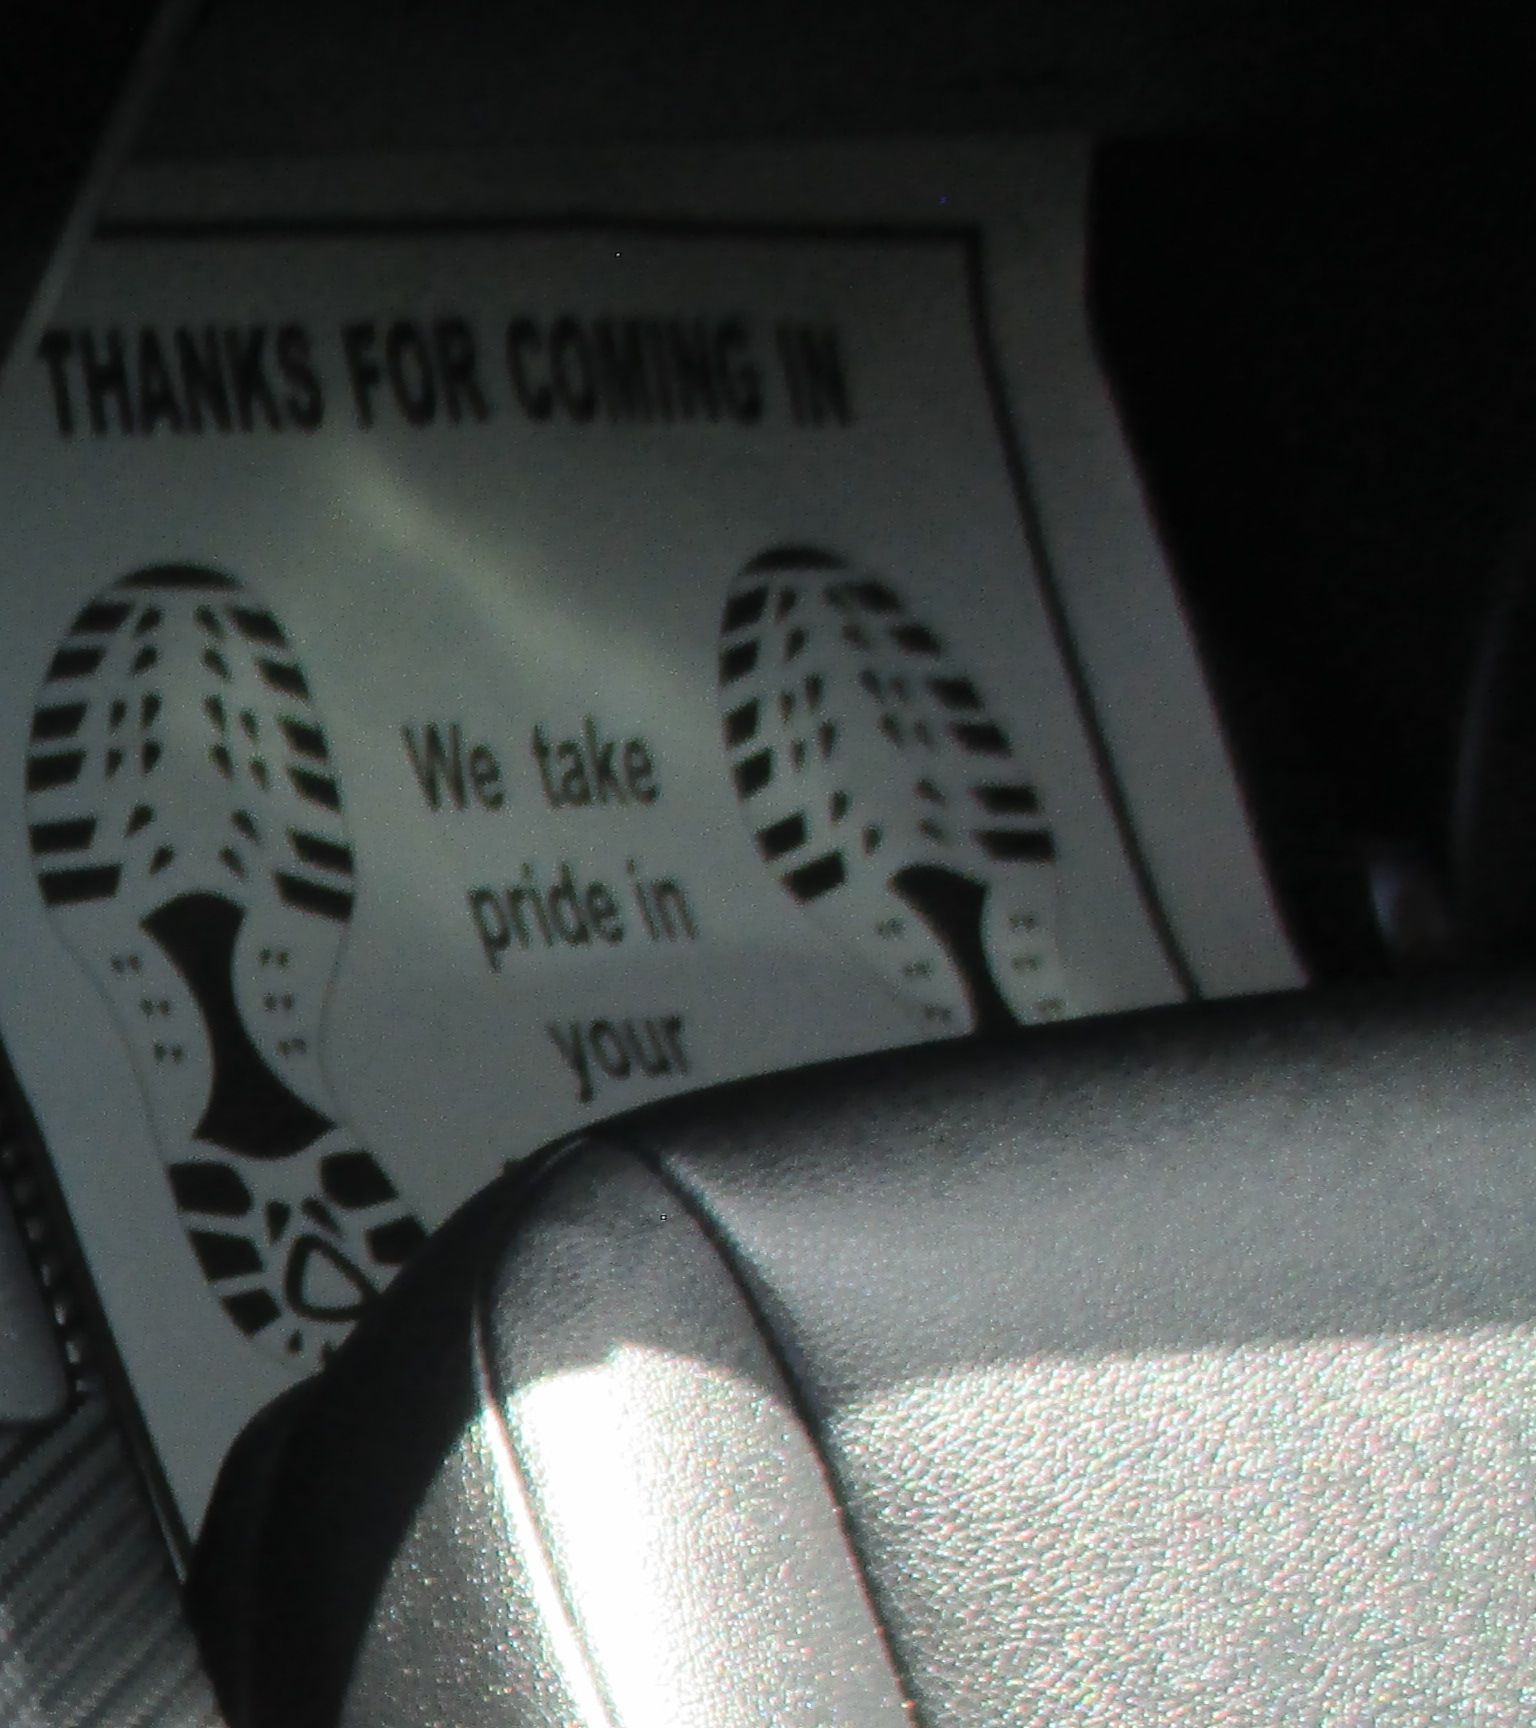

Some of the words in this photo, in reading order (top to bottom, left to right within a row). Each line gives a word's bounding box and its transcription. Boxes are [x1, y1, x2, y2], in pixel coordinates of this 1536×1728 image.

[34, 321, 324, 439] THANKS
[340, 316, 490, 430] FOR
[505, 312, 765, 428] COMING
[783, 316, 853, 428] IN
[403, 721, 506, 812] We
[531, 715, 660, 808] take
[467, 860, 625, 972] pride
[626, 857, 699, 942] in
[545, 1012, 690, 1104] your
